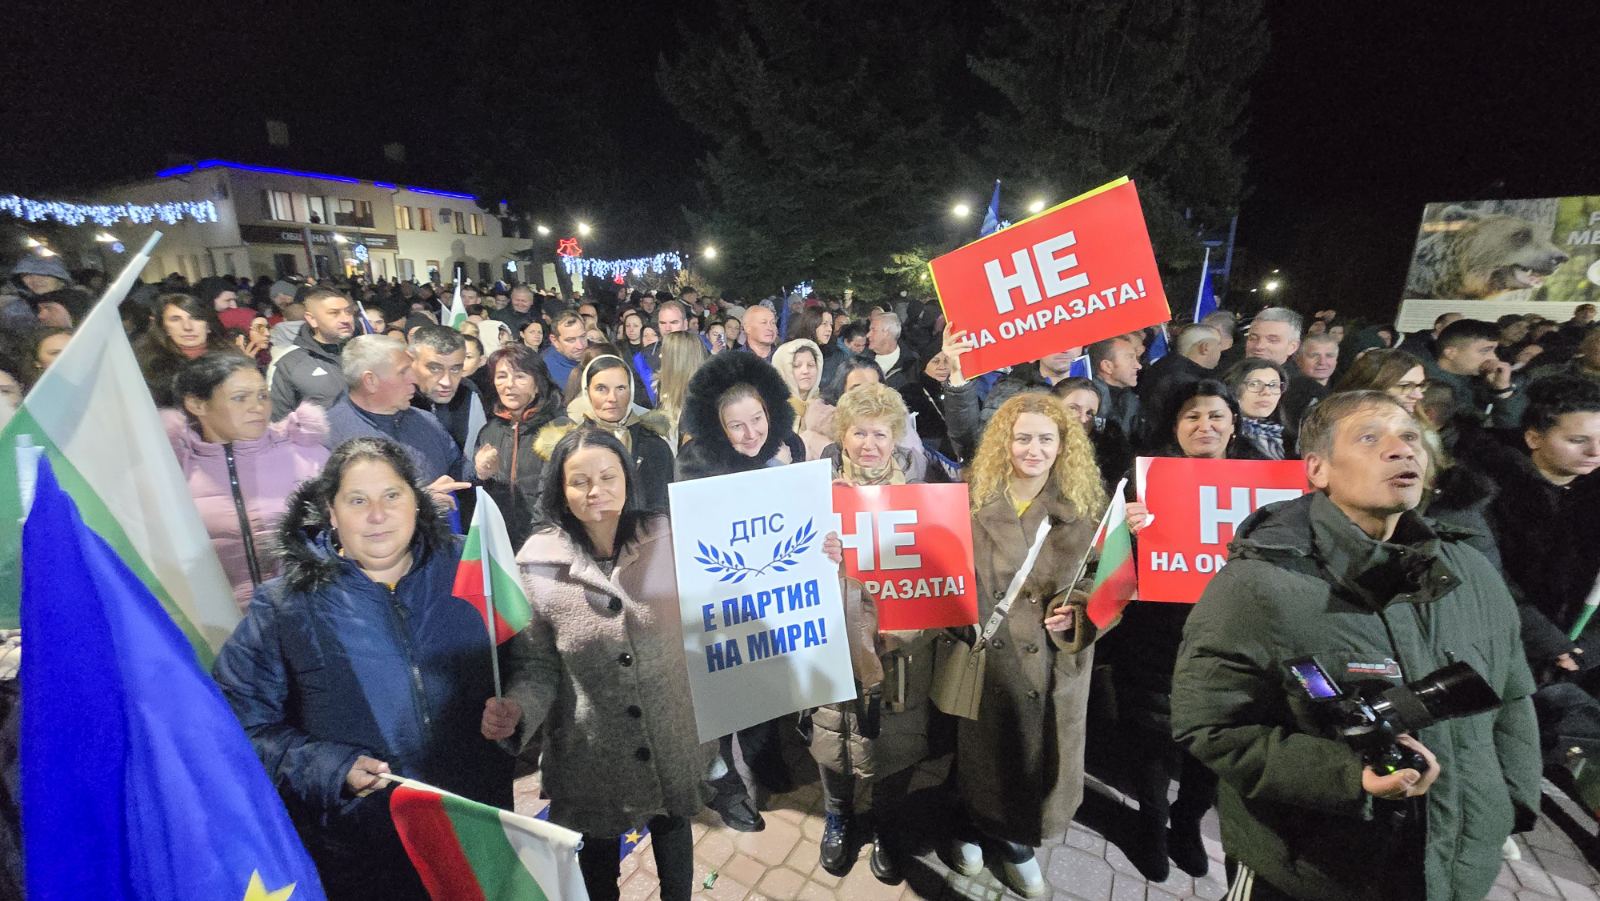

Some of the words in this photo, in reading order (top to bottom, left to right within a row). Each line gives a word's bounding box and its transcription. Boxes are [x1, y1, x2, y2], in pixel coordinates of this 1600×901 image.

[984, 231, 1089, 314] НЕ
[999, 278, 1147, 340] ОМРАЗАТА!
[730, 512, 785, 546] ДПС
[1199, 485, 1303, 544] Н
[864, 575, 965, 600] РАЗАТА!
[1151, 551, 1189, 572] НА
[702, 603, 717, 632] Е
[722, 579, 820, 627] ПАРТИЯ
[705, 639, 743, 673] НА
[746, 618, 828, 661] МИРА!
